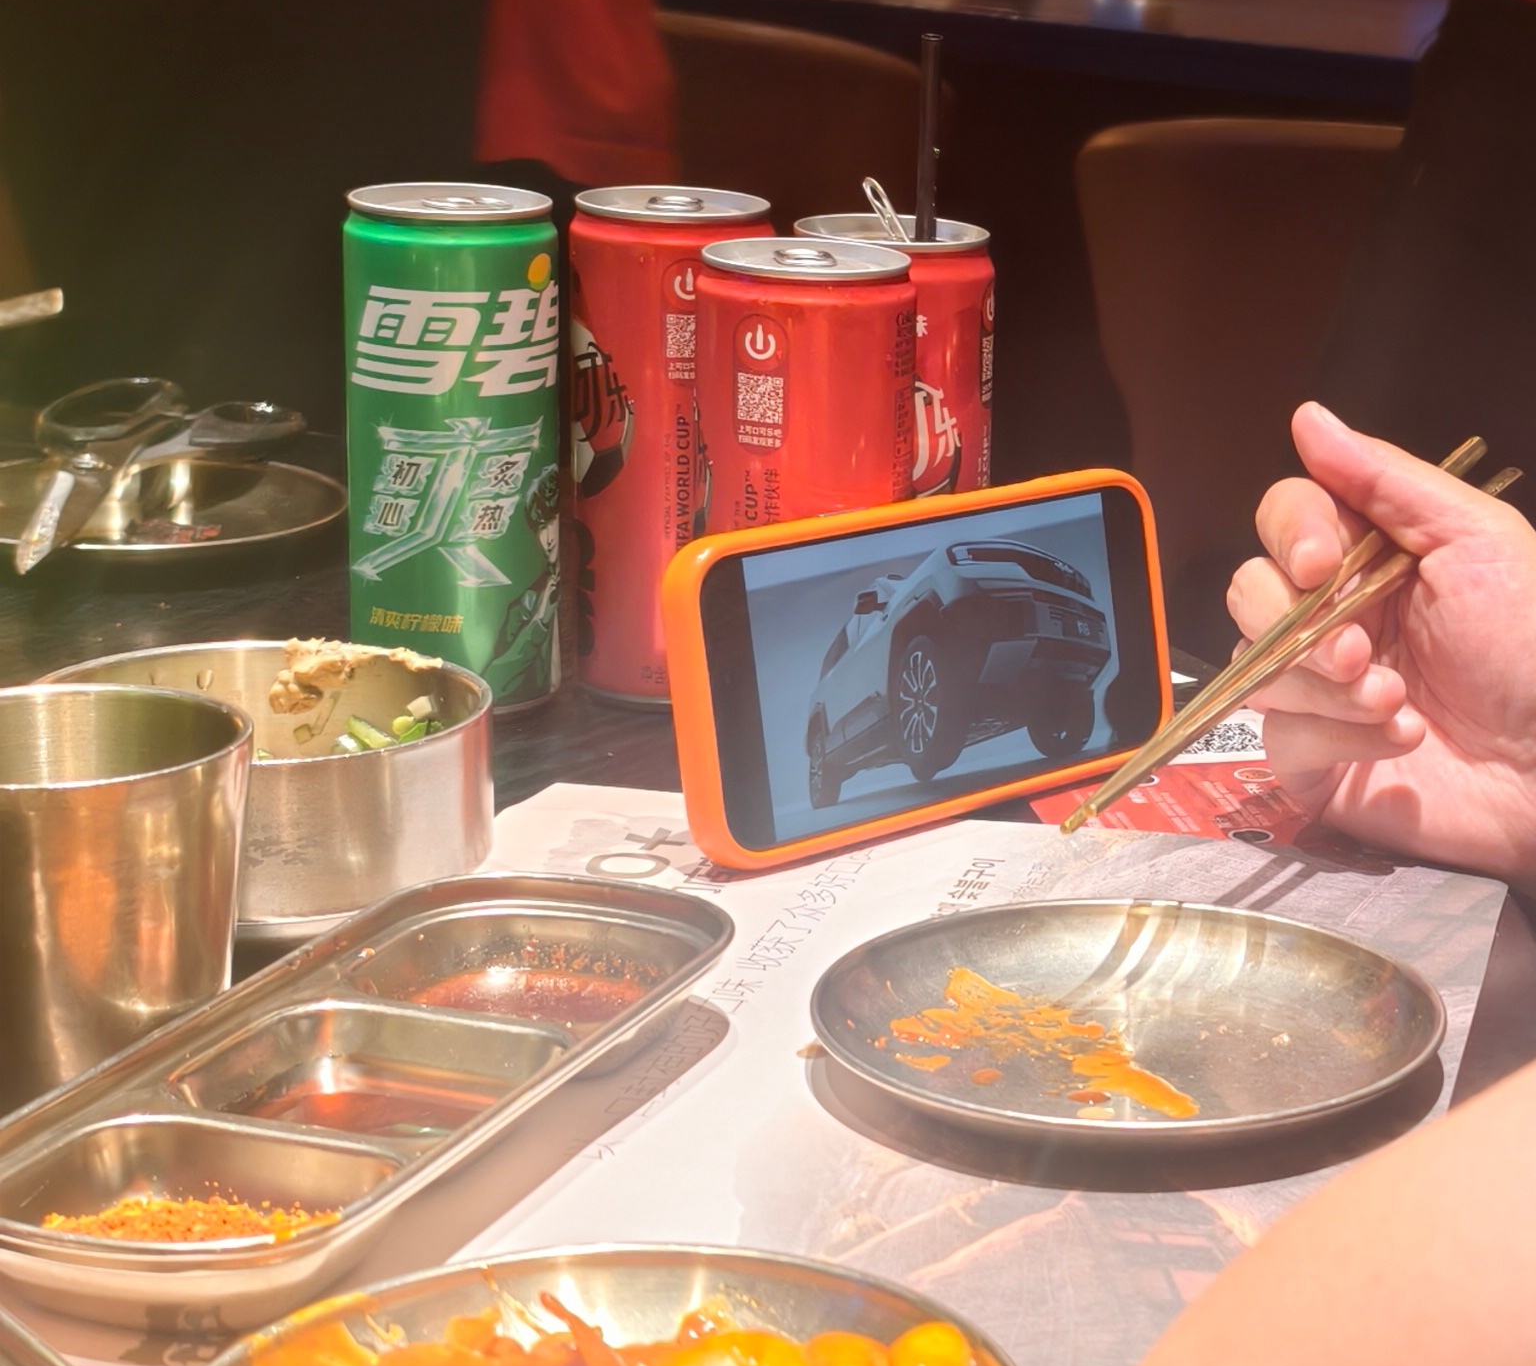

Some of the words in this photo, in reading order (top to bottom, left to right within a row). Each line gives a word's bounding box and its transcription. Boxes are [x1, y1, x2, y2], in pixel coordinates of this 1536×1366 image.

[351, 280, 559, 397] 雪碧
[378, 460, 421, 527] 初心
[473, 460, 521, 531] 炙热
[676, 455, 690, 517] WORLD
[369, 606, 464, 633] 清爽柠檬味
